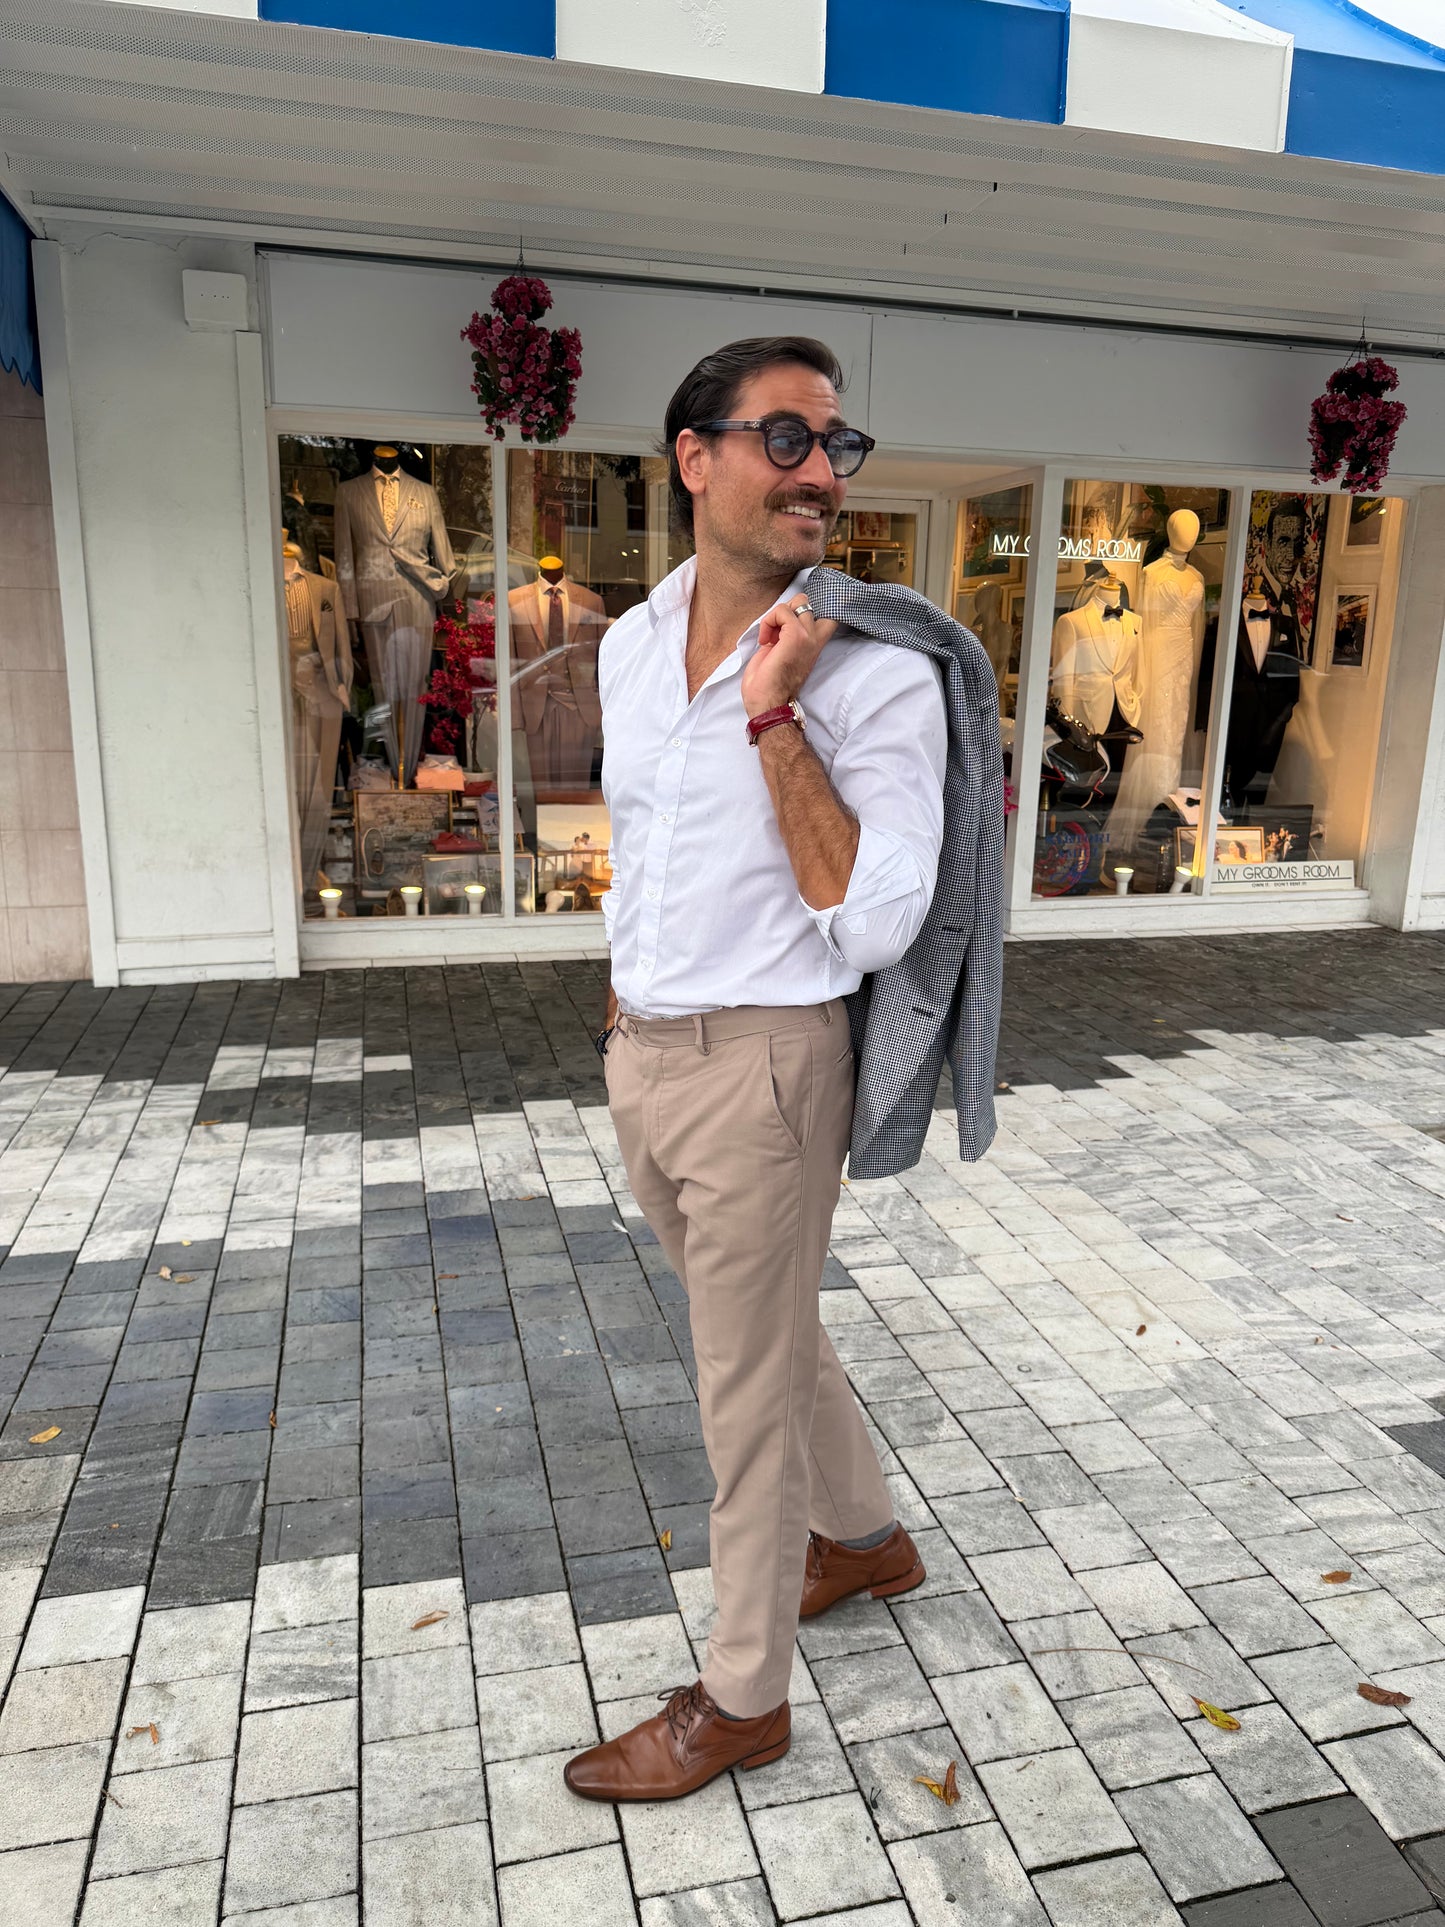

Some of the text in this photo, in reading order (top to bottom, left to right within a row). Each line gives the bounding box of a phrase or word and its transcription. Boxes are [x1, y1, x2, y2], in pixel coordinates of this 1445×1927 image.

[993, 534, 1141, 560] MY OMS ROOM
[1217, 865, 1340, 880] MY GROOMS ROOM
